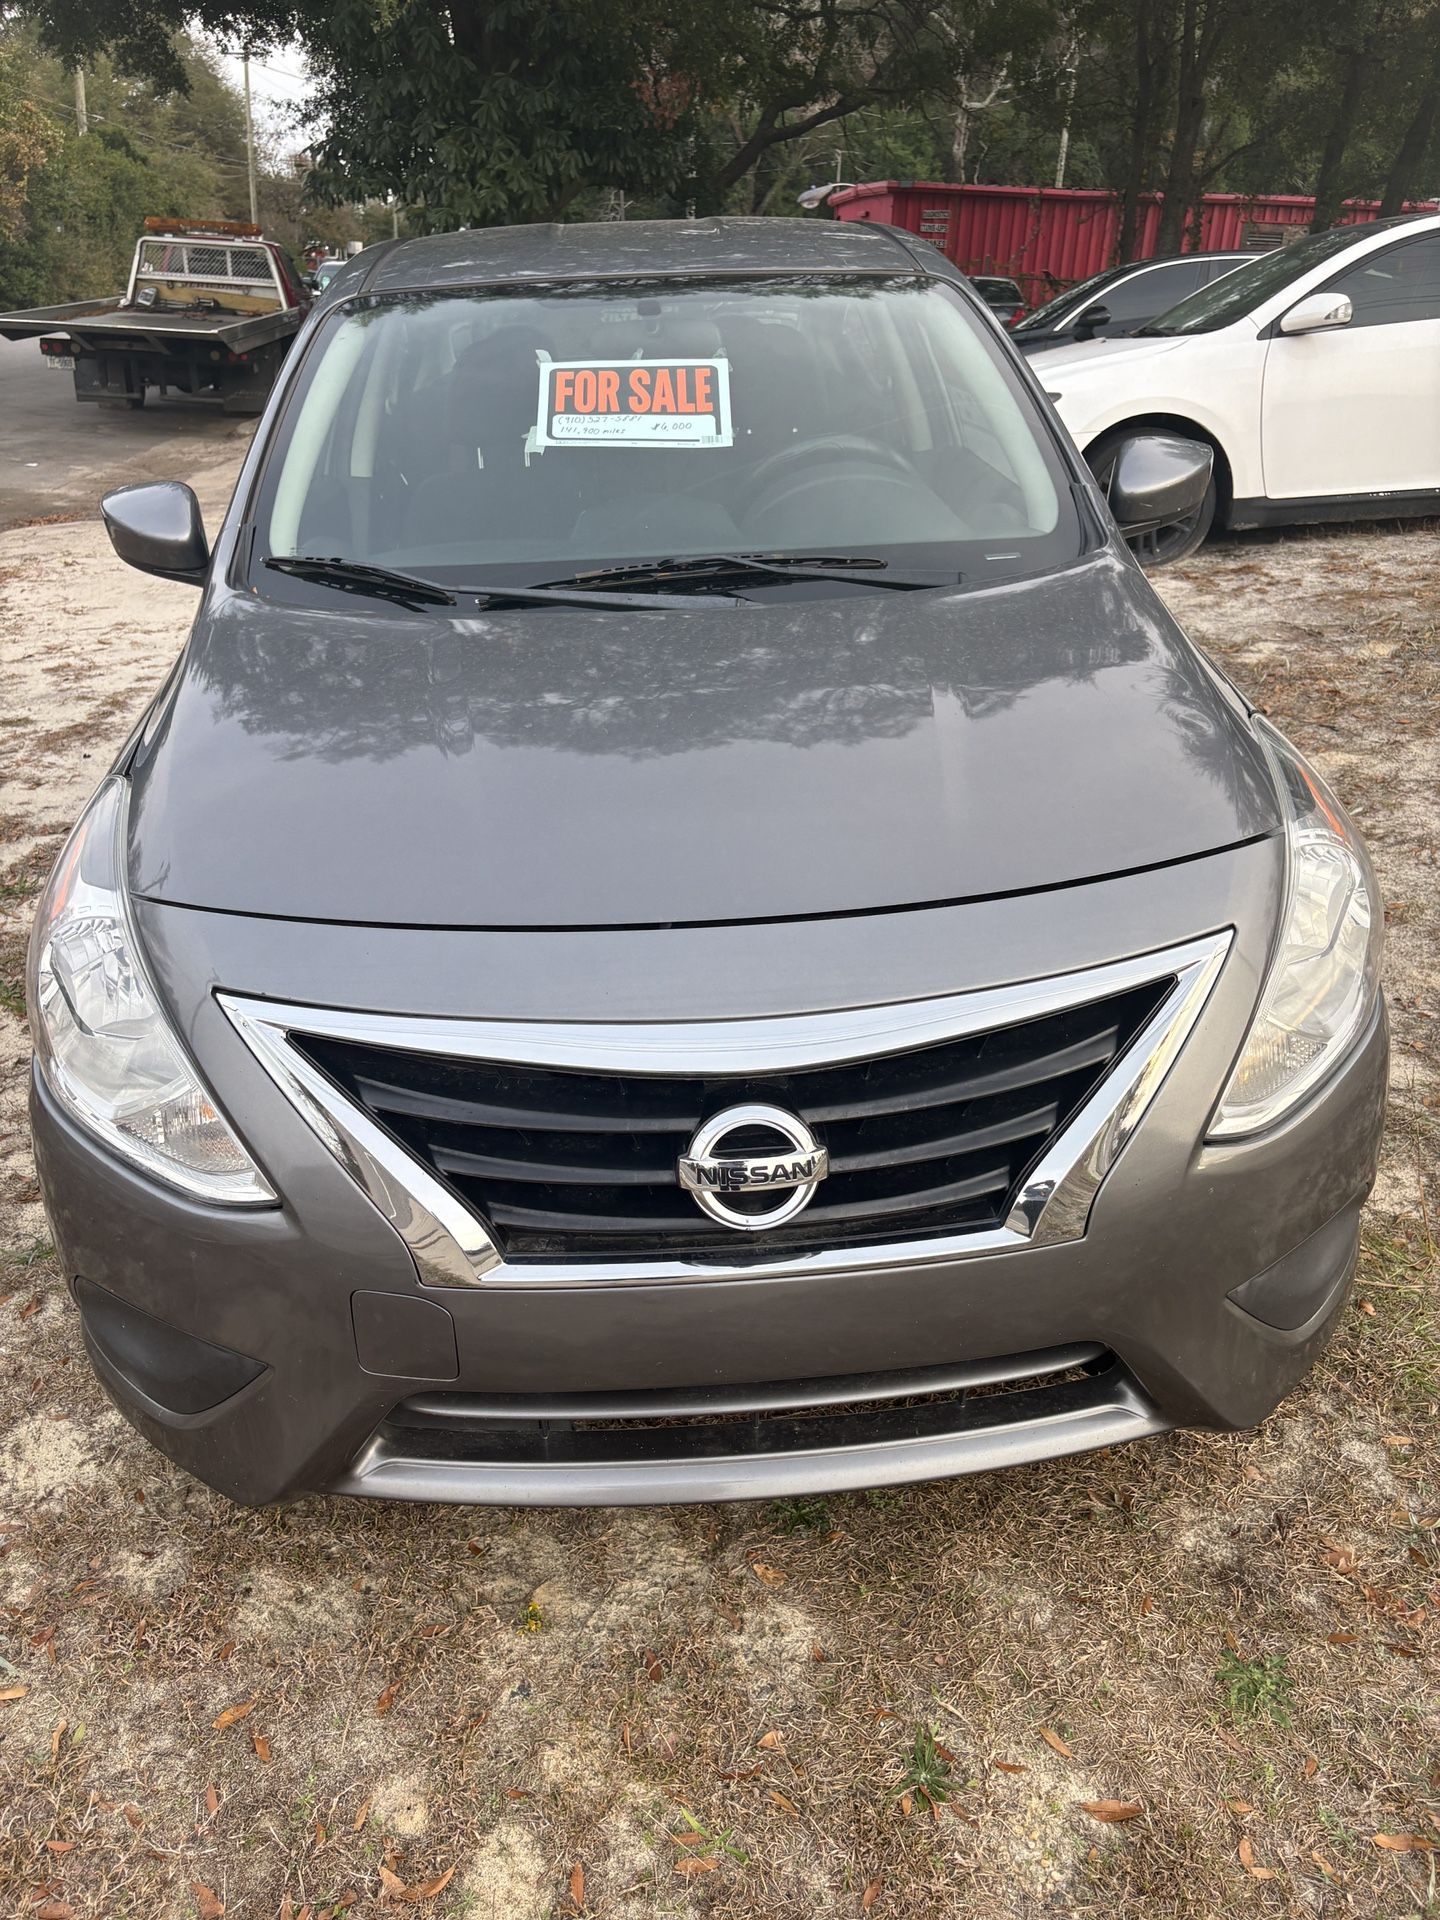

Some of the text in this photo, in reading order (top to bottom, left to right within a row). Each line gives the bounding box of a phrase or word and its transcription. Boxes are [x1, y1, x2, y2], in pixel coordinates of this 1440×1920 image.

[555, 368, 714, 413] FOR SALE
[696, 1159, 813, 1186] NISSAN
